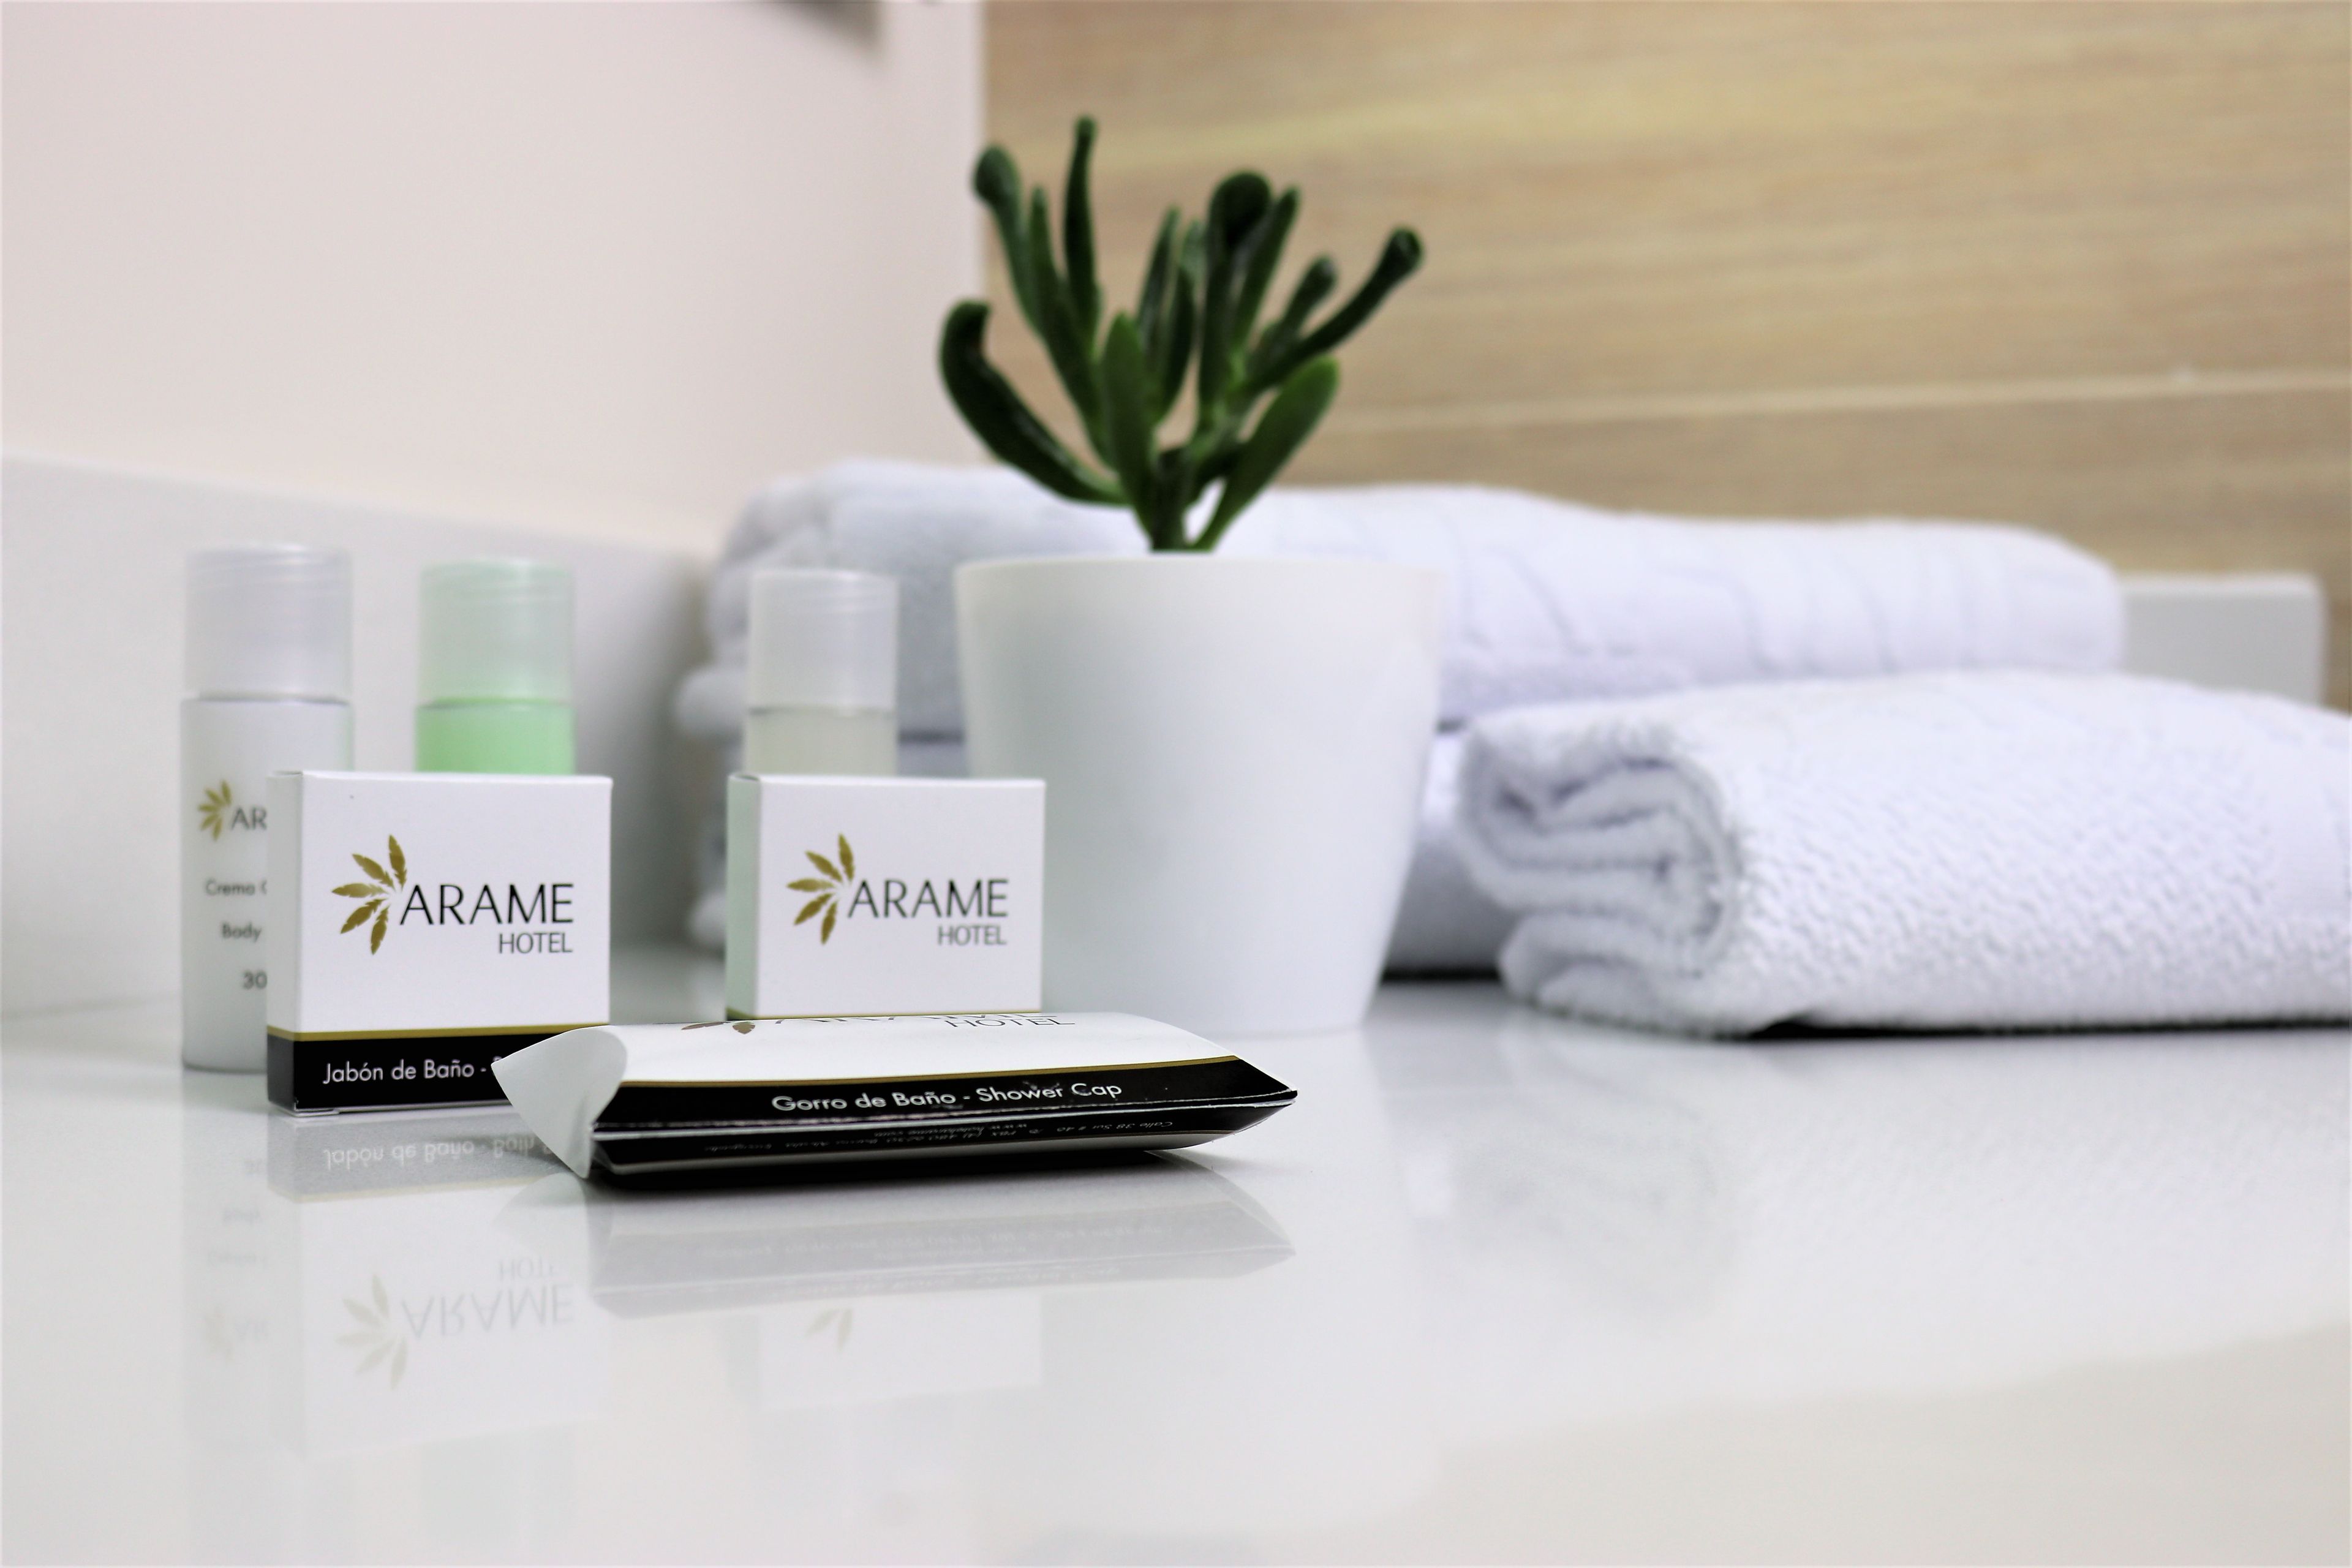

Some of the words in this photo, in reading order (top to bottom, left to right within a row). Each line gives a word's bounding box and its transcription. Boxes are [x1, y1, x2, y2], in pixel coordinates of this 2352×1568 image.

[205, 880, 255, 896] Crema
[848, 878, 1009, 919] ARAME
[399, 883, 575, 925] ARAME
[221, 922, 262, 941] Body
[937, 924, 1007, 946] HOTEL
[498, 932, 573, 955] HOTEL
[243, 971, 266, 990] 30
[944, 1018, 1076, 1028] HOTEL
[323, 1061, 384, 1085] Jabón
[391, 1058, 417, 1080] de
[424, 1058, 475, 1080] Baño
[771, 1095, 848, 1112] Gorro
[854, 1092, 887, 1108] de
[891, 1090, 957, 1107] Baño
[975, 1083, 1063, 1102] Shower
[1071, 1082, 1123, 1099] Cap
